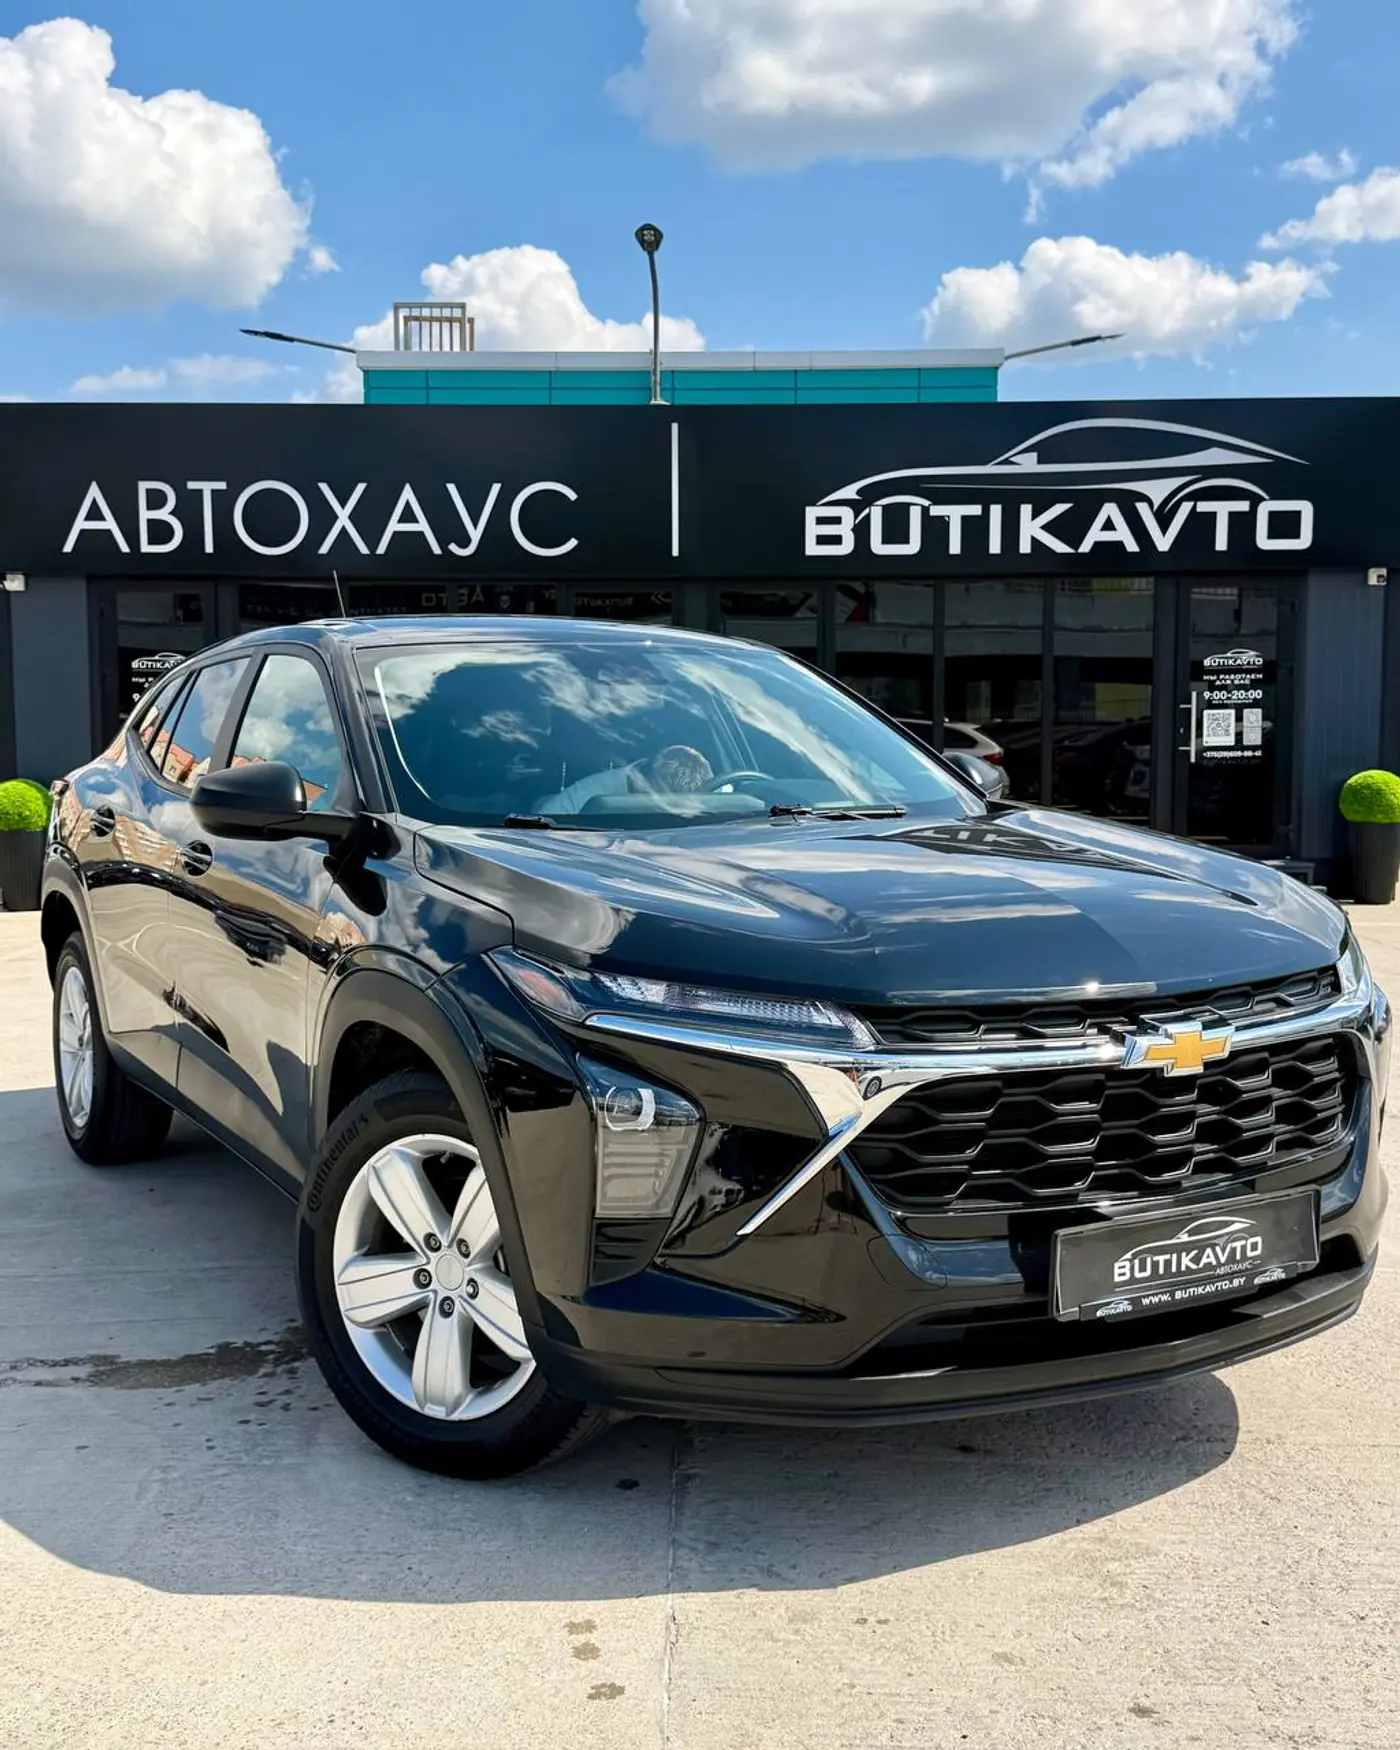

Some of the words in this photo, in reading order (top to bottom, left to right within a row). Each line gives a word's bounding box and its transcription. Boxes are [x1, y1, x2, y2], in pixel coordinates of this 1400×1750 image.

[62, 480, 579, 557] АВТОХАУС
[805, 499, 1314, 556] BUTIKAVTO
[1203, 658, 1263, 666] BUTIKAVTO
[1203, 690, 1263, 700] 9:00-20:00
[306, 1119, 361, 1214] Continental
[1113, 1236, 1262, 1283] BUTIKAVTO
[1174, 1276, 1246, 1300] BUTIKAVTO.BY
